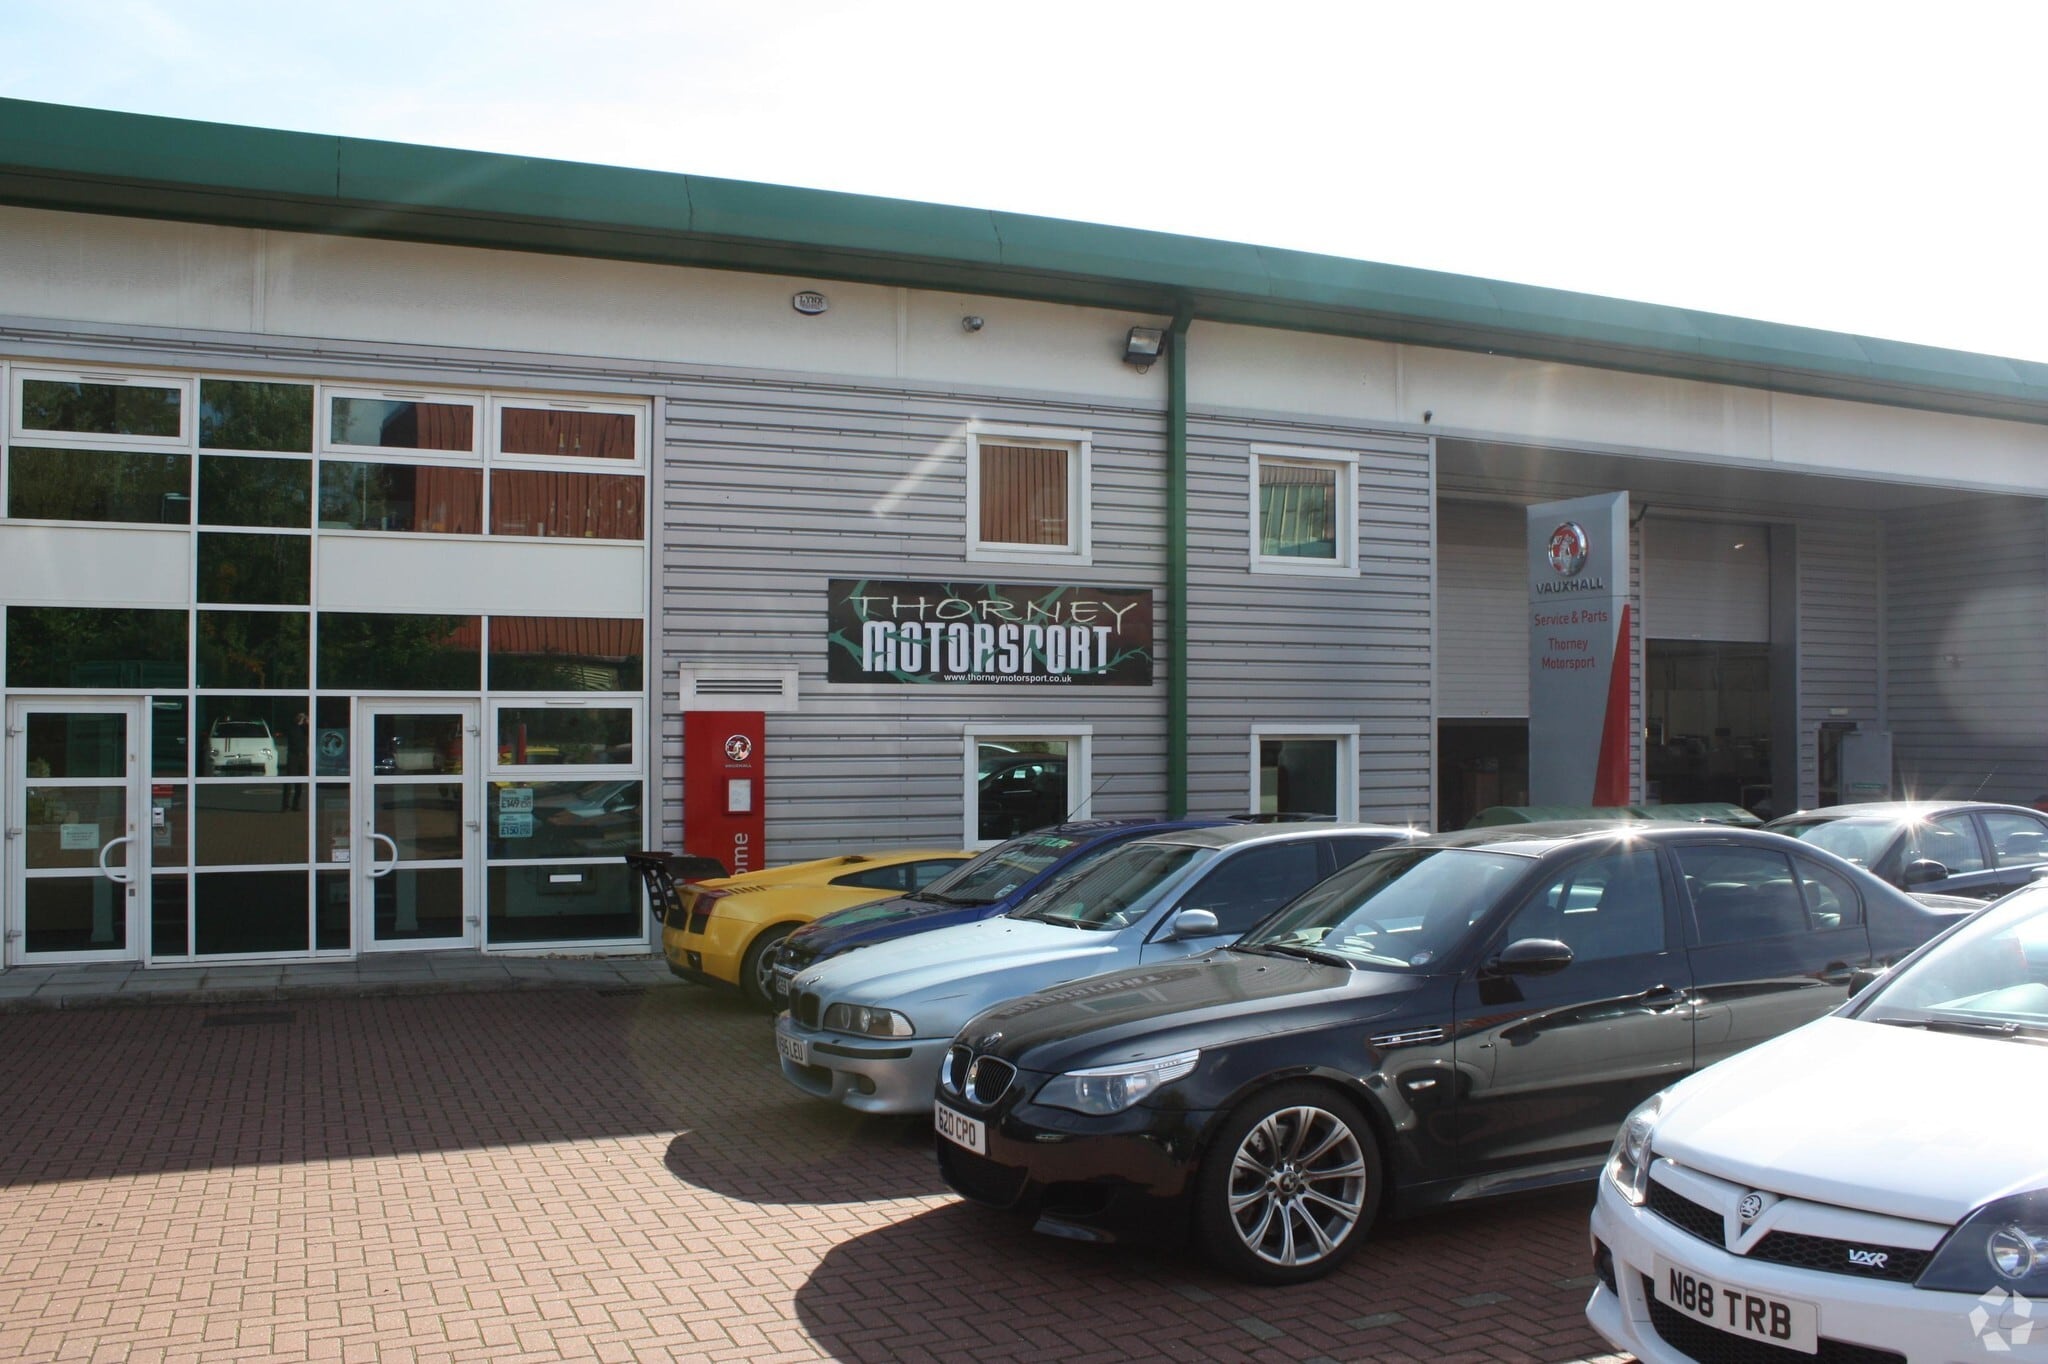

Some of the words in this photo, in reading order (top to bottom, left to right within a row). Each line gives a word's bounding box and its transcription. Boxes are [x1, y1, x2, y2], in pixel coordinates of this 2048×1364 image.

[1536, 577, 1604, 595] VAUXHALL
[849, 594, 1138, 636] THORNEY
[1535, 613, 1569, 626] Service
[1571, 611, 1579, 624] &
[1582, 609, 1608, 623] Parts
[862, 620, 1112, 674] MOTORSPORT
[1548, 638, 1588, 653] Thorney
[1542, 656, 1596, 671] Motorsport
[944, 673, 1072, 684] www.thorneymotorsport.co.uk
[956, 1116, 976, 1146] CPO
[1848, 1249, 1888, 1268] VXR
[1669, 1267, 1714, 1319] N88
[1723, 1289, 1792, 1341] TRB
